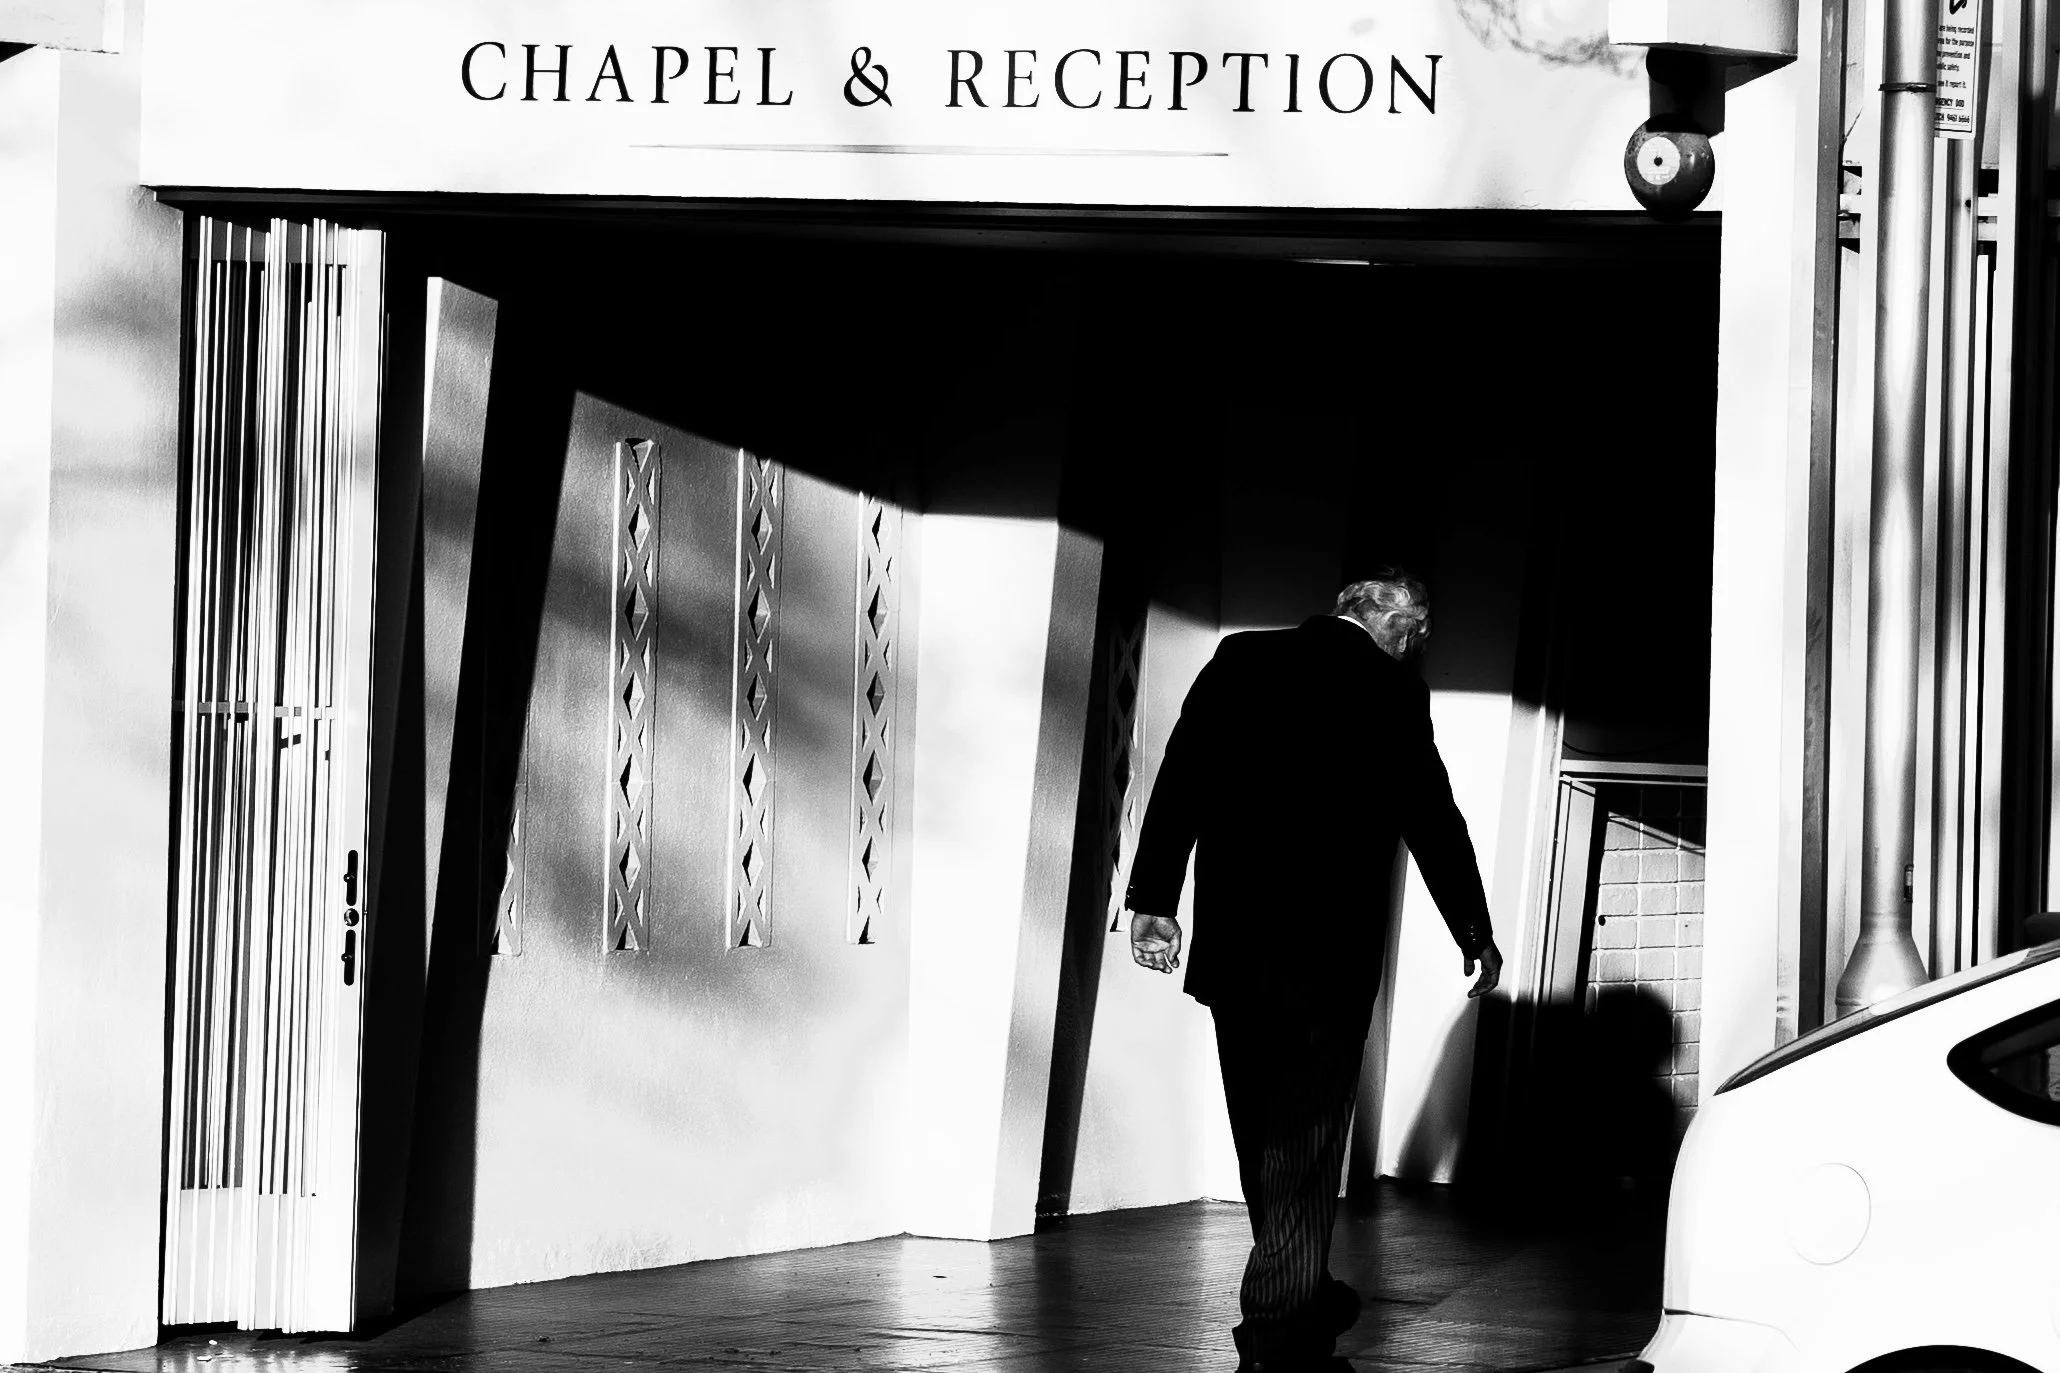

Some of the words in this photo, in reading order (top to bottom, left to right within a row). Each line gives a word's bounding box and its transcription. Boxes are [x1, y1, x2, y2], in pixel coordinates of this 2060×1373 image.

[461, 41, 793, 106] CHAPEL
[843, 46, 893, 107] &
[945, 49, 1443, 114] RECEPTION
